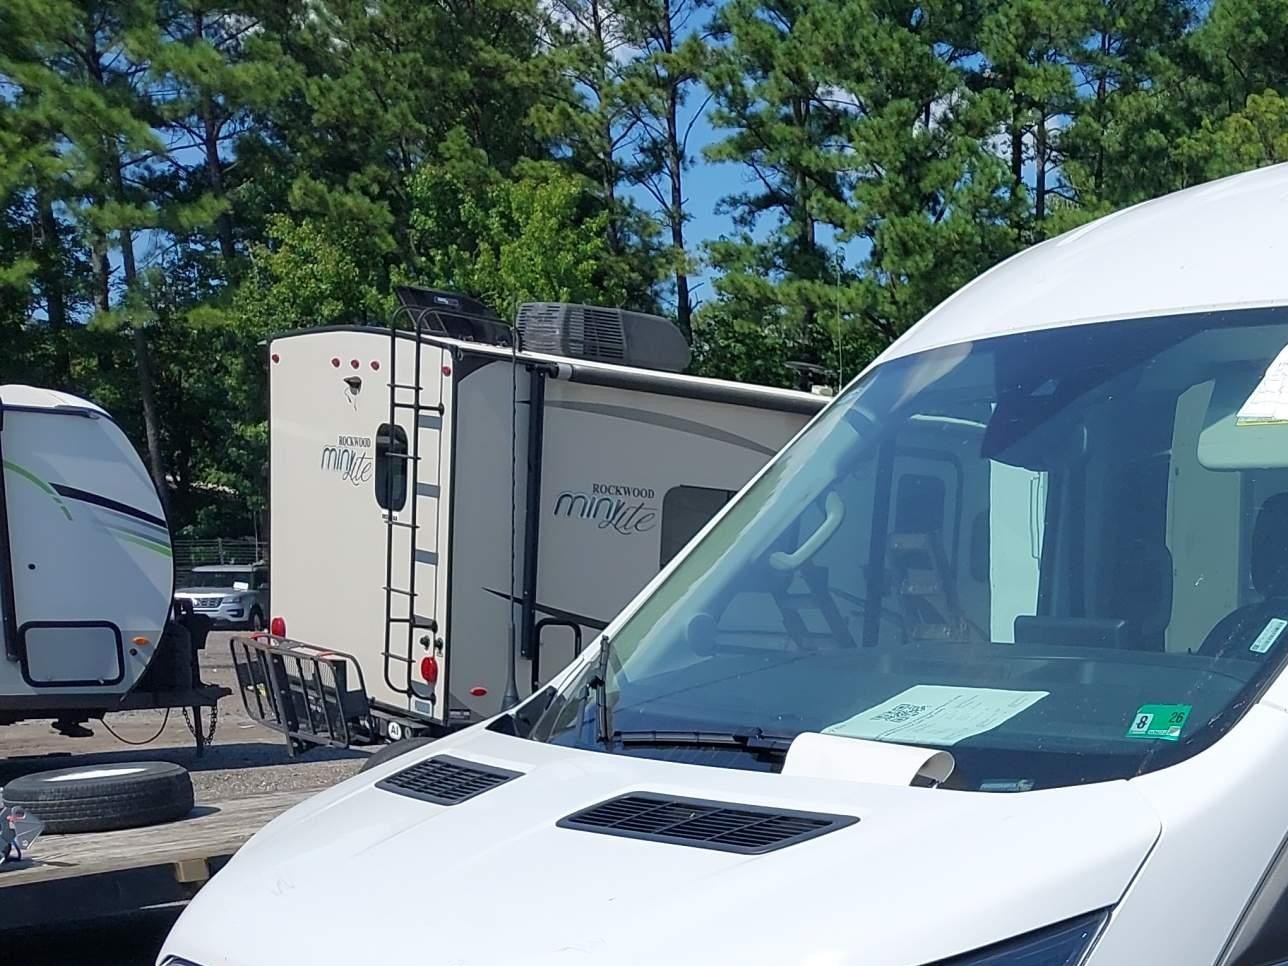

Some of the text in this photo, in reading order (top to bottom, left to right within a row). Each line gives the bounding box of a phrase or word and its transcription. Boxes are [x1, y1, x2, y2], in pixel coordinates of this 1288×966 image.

[338, 435, 371, 448] ROCKWOOD
[592, 483, 655, 499] ROCKWOOD
[1137, 716, 1148, 729] 8
[1169, 712, 1184, 723] 26
